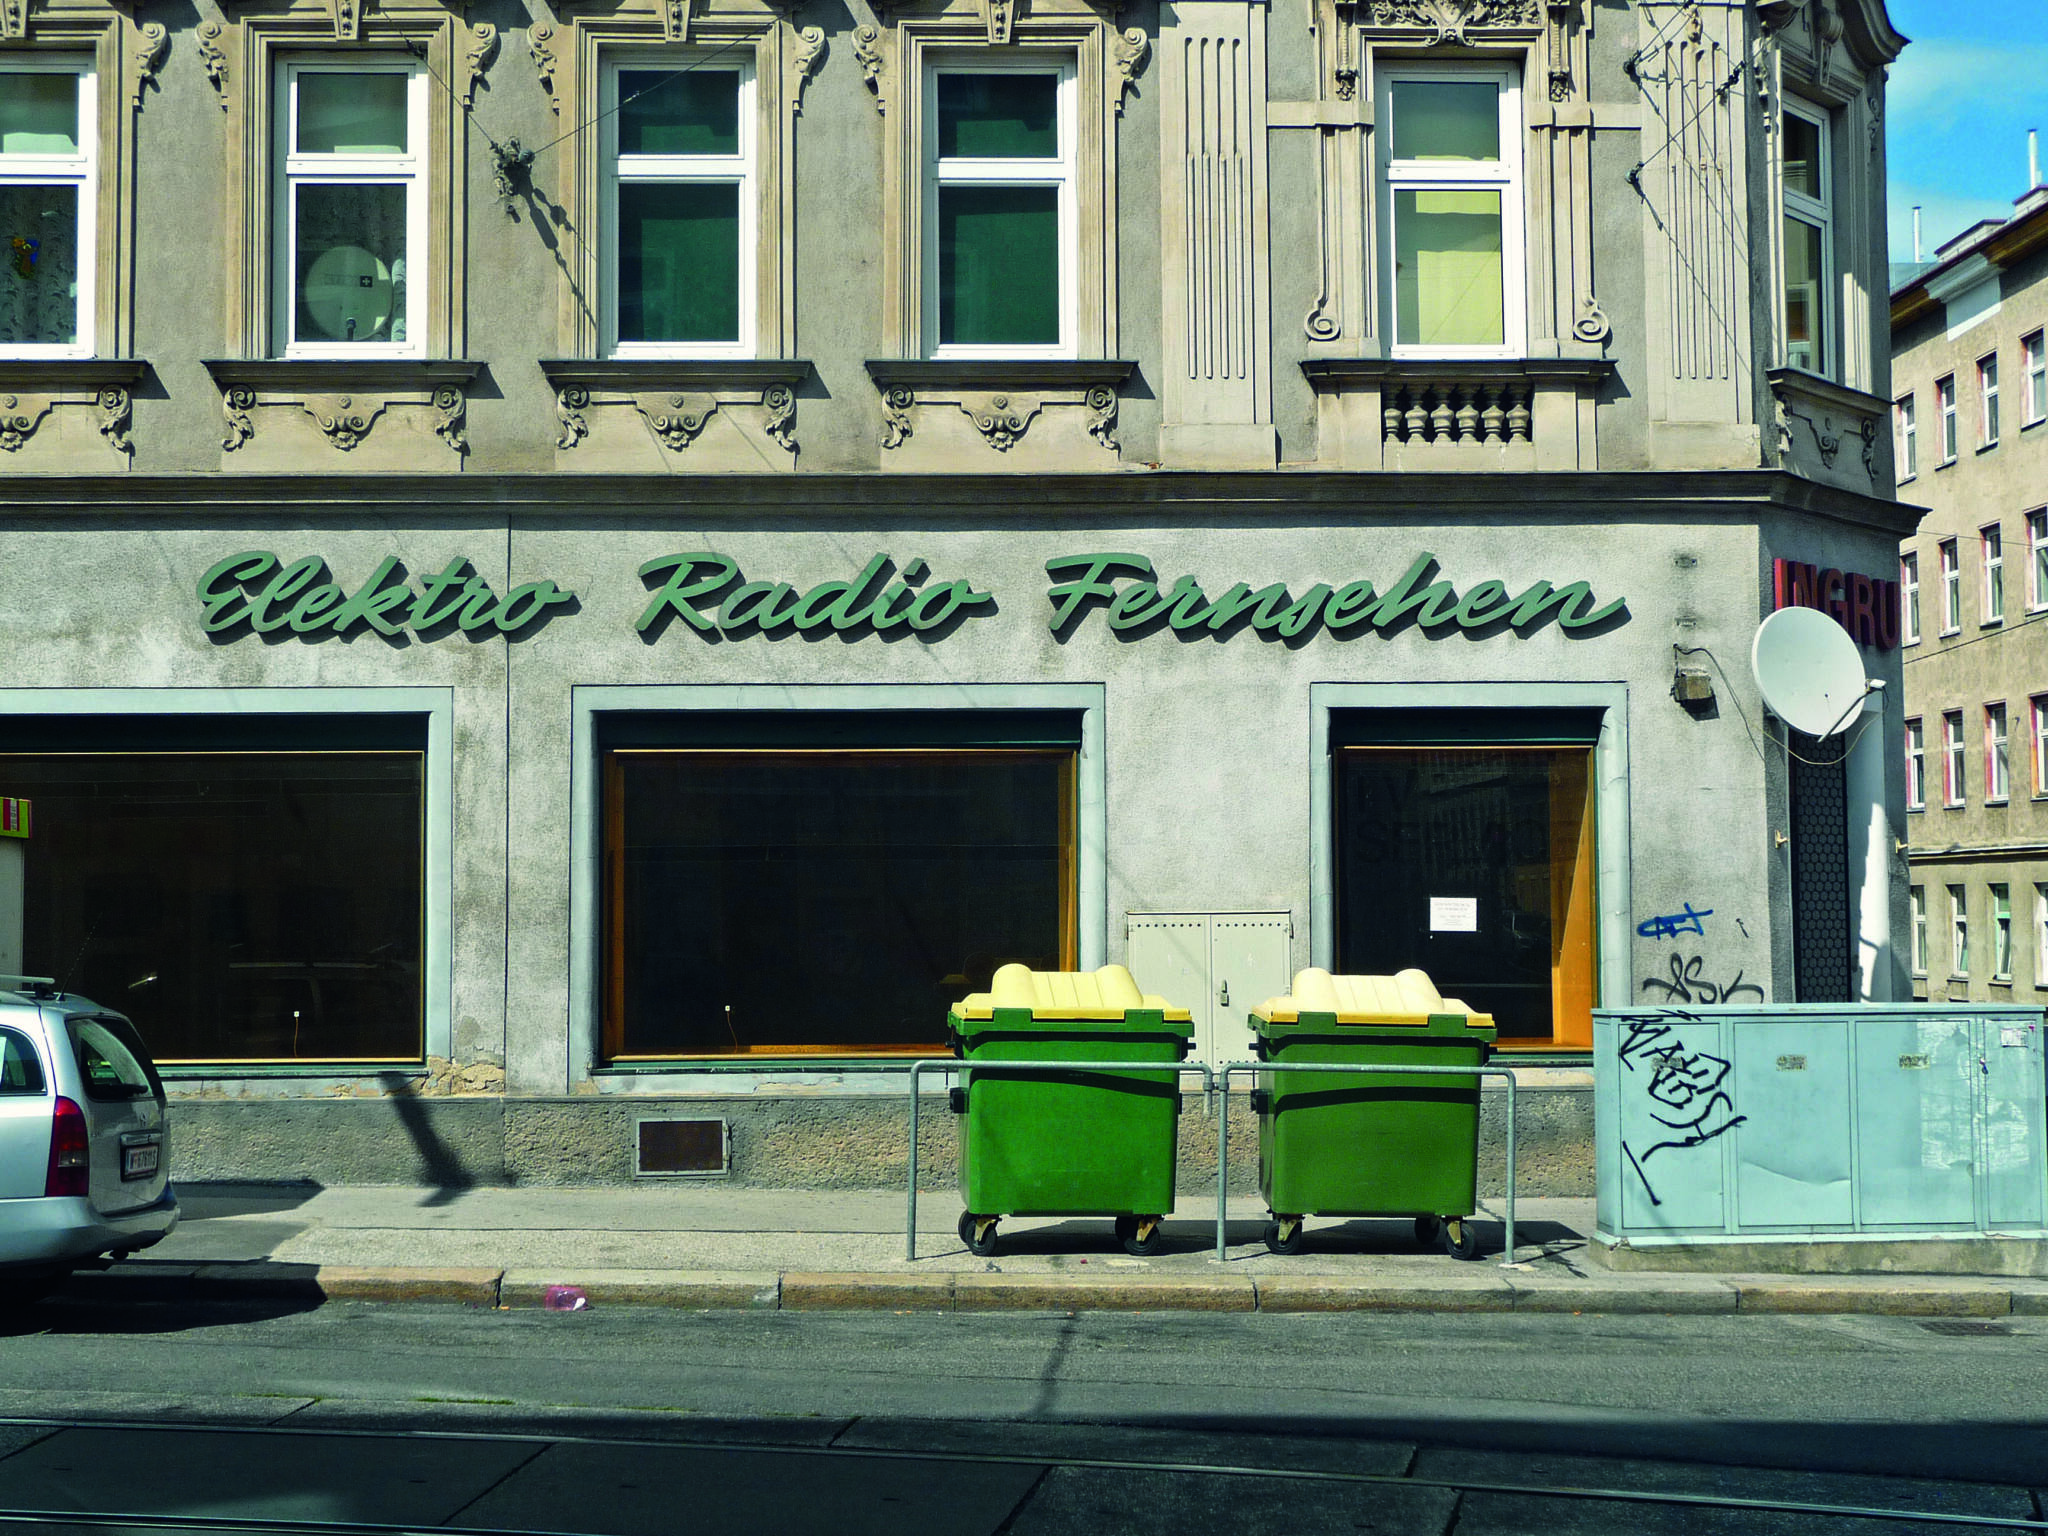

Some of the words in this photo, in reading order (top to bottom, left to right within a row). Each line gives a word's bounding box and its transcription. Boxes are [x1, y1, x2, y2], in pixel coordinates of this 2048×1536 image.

[196, 550, 574, 636] Elektro
[635, 552, 992, 632] Radio
[1044, 551, 1626, 637] Fernsehen
